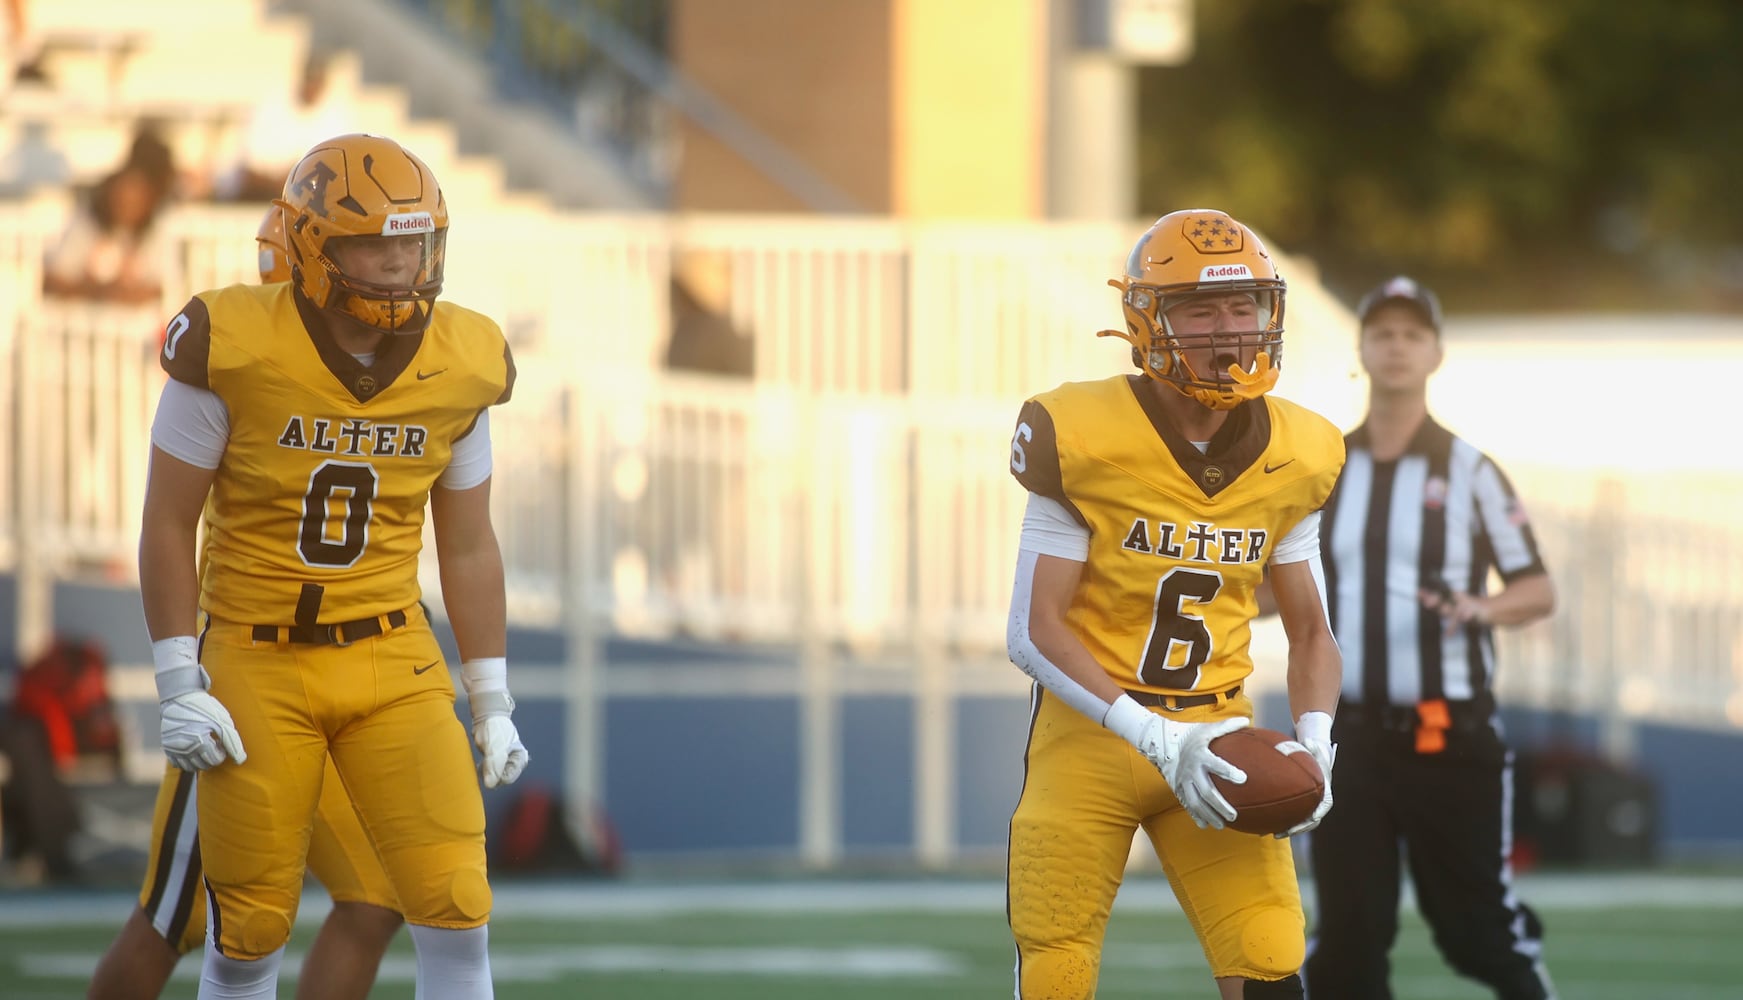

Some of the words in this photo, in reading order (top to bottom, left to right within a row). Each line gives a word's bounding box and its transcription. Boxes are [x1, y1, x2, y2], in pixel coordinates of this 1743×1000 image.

[292, 160, 337, 217] A
[390, 216, 431, 230] Riddell
[1207, 266, 1247, 277] Riddell
[164, 313, 190, 360] 0
[277, 416, 428, 457] ALTER
[1012, 422, 1032, 473] 6
[296, 459, 379, 568] 0
[1121, 517, 1268, 565] ALTER
[1136, 566, 1223, 691] 6
